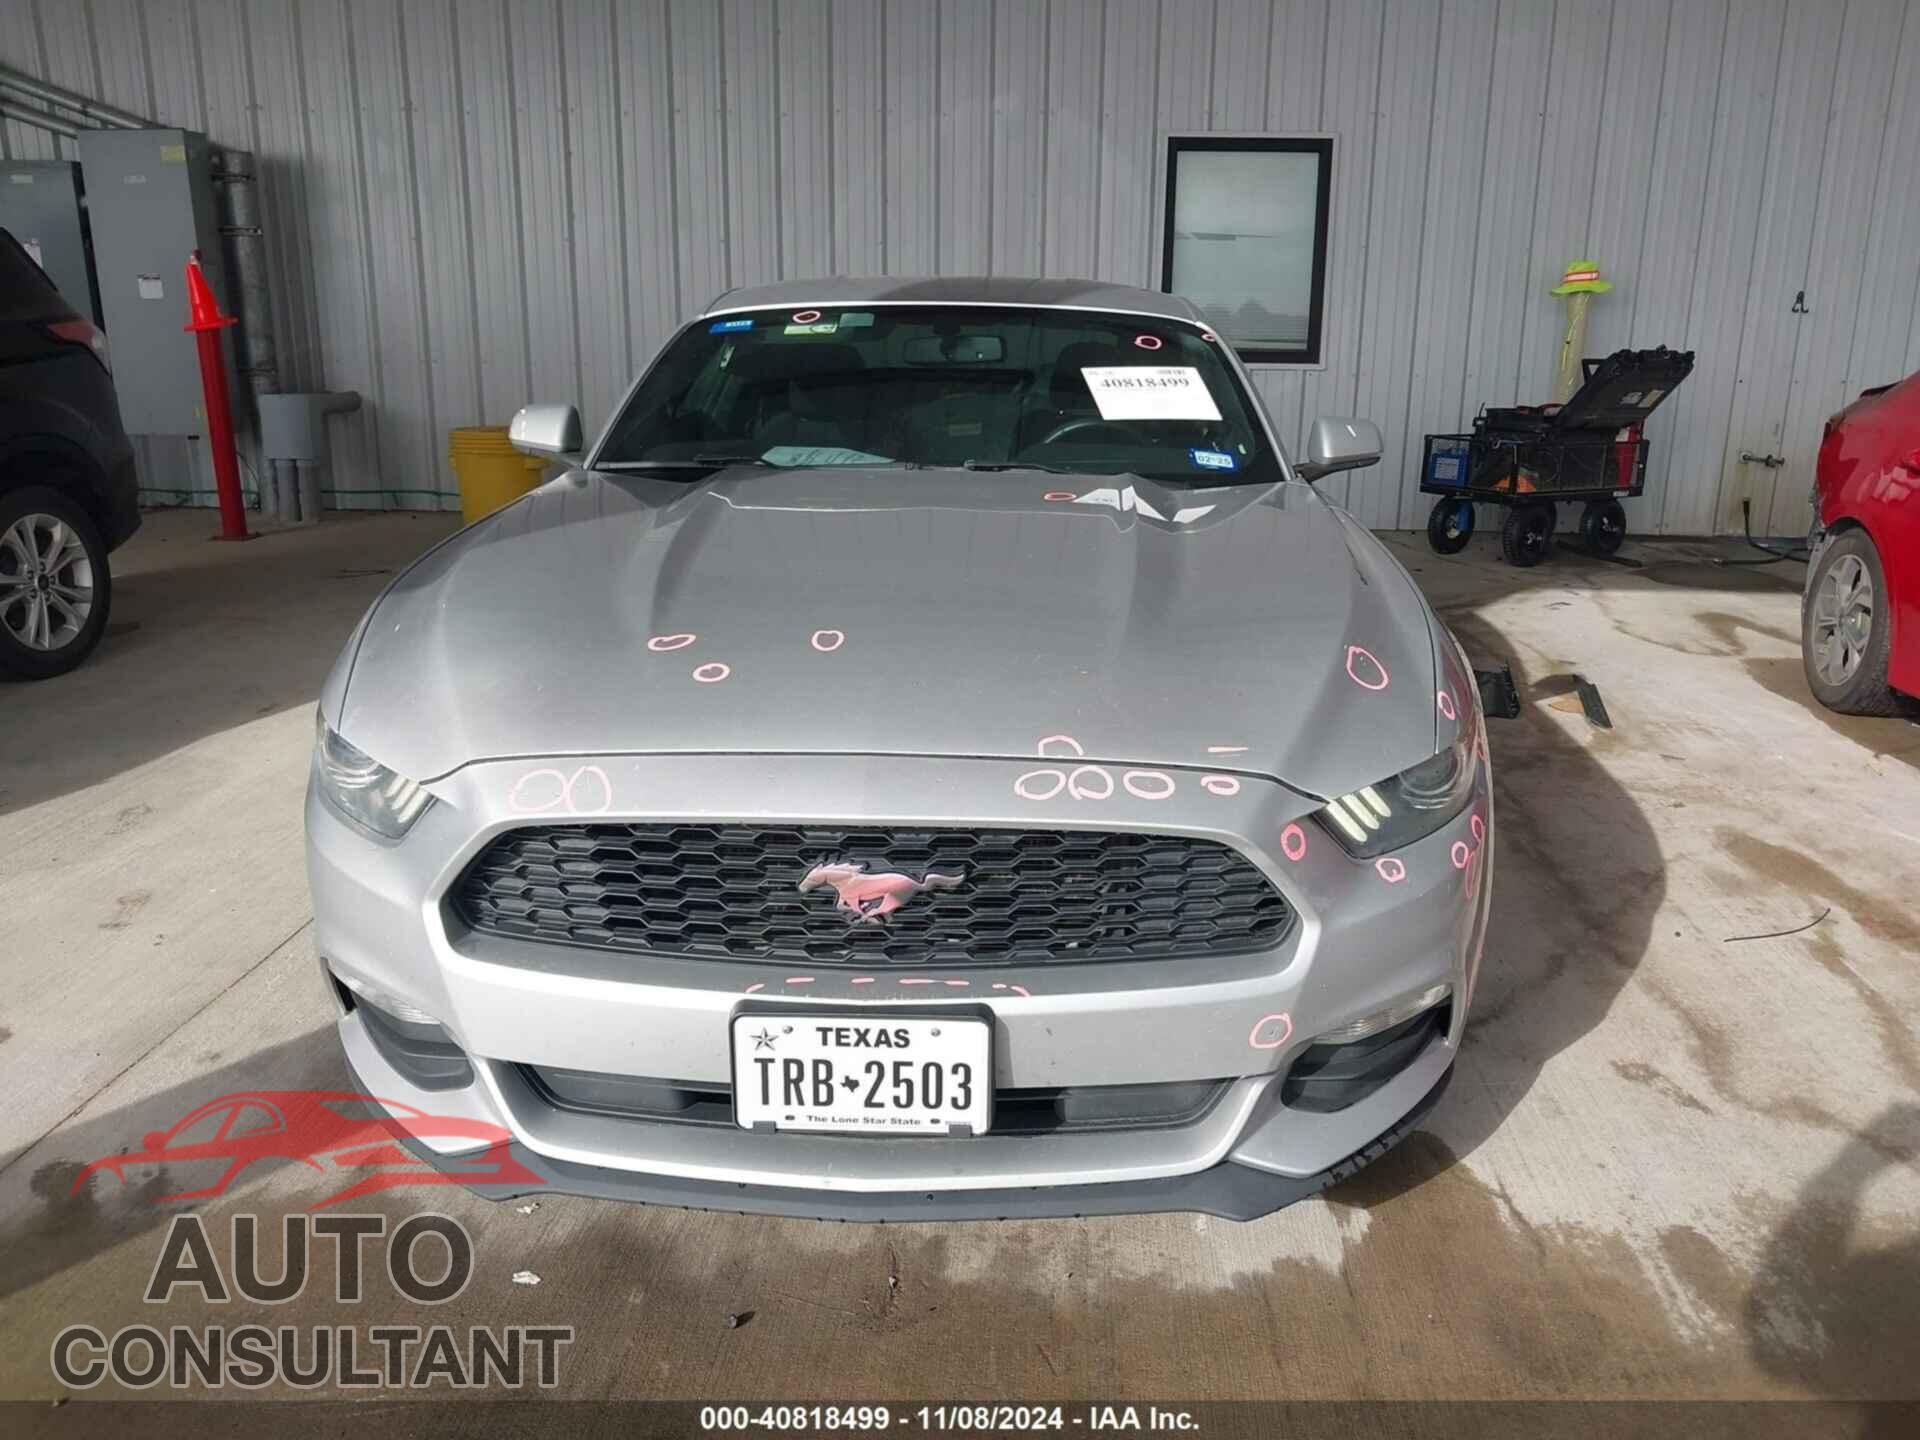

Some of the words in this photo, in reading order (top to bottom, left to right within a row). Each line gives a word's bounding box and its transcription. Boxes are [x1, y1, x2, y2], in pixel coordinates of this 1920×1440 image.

[1101, 378, 1190, 388] 40818499
[816, 1027, 910, 1049] TEXAS
[754, 1057, 834, 1107] TRB
[864, 1060, 972, 1110] 2503
[806, 1114, 828, 1123] The
[831, 1115, 859, 1124] Lone
[863, 1116, 886, 1125] Star
[890, 1117, 921, 1126] State
